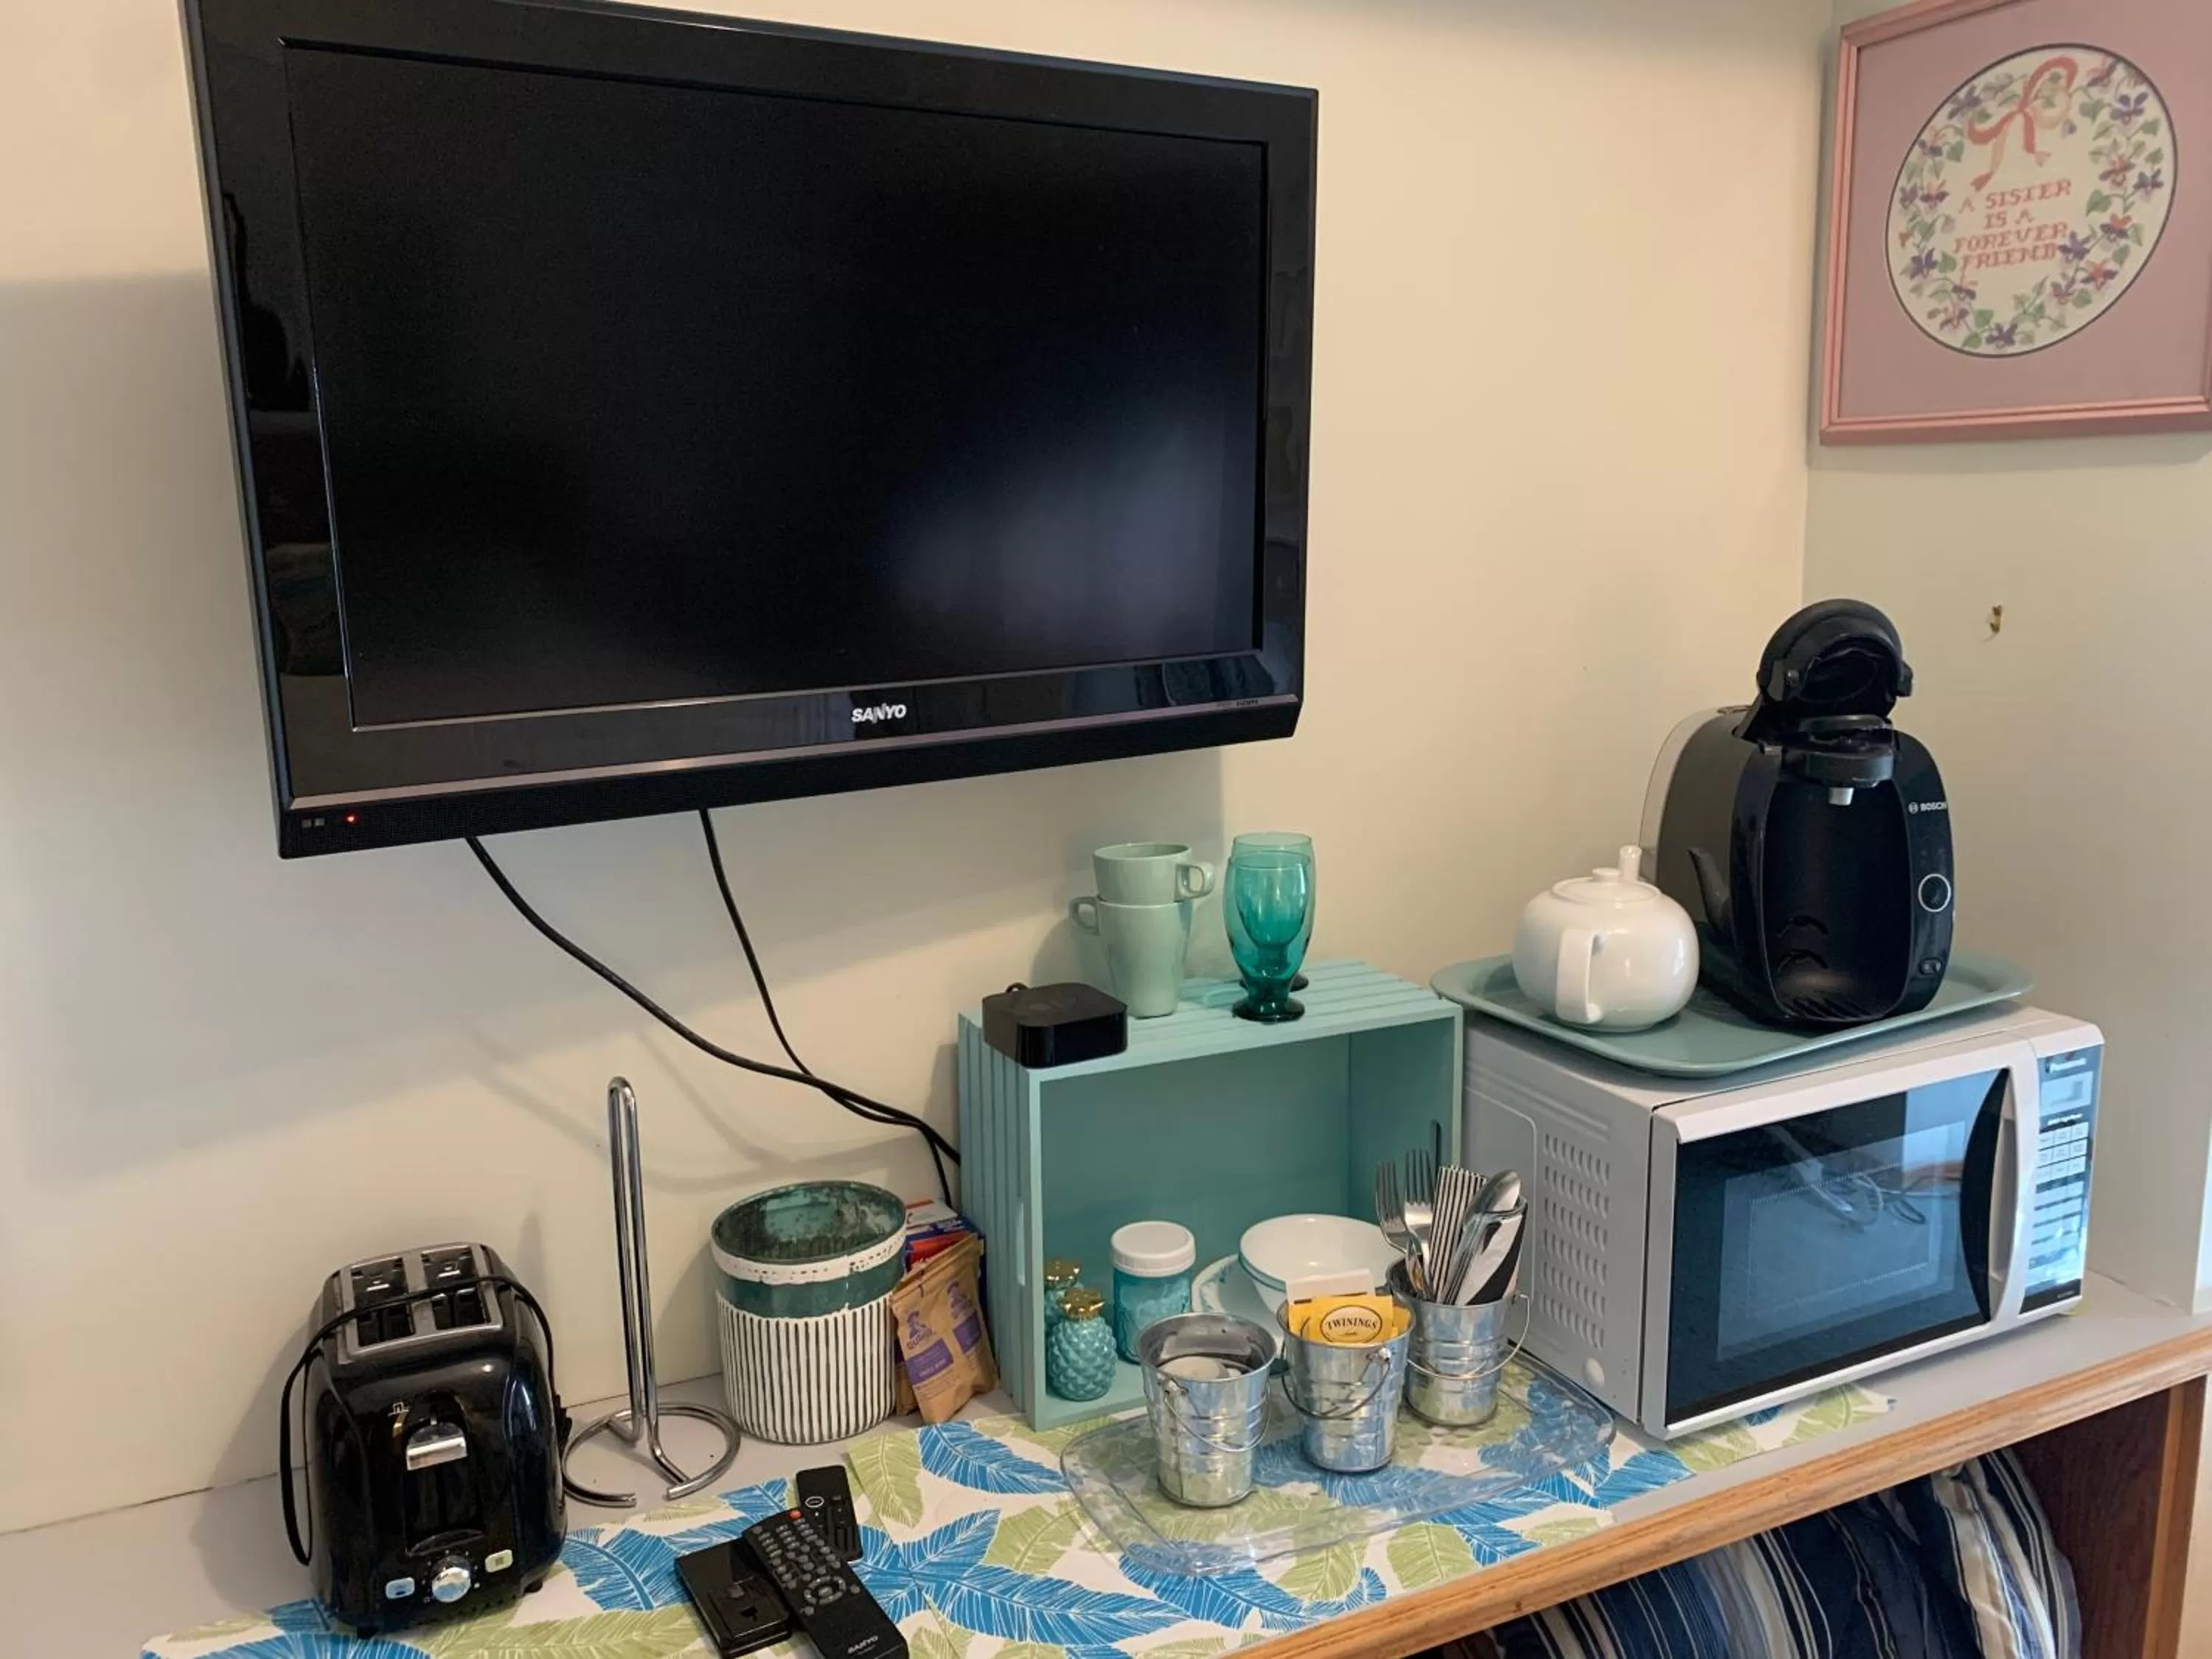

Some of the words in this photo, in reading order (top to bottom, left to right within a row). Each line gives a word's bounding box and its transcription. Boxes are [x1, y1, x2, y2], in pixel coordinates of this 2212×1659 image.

[1958, 196, 1975, 215] A
[1985, 177, 2072, 209] SISTER
[1984, 211, 2008, 229] IS
[2014, 209, 2034, 225] A
[1953, 221, 2068, 254] FOREVER
[1961, 242, 2057, 271] FRIEND
[851, 703, 907, 724] SANYO
[1920, 801, 1947, 812] BOSCH
[1326, 1318, 1378, 1330] TWININGS
